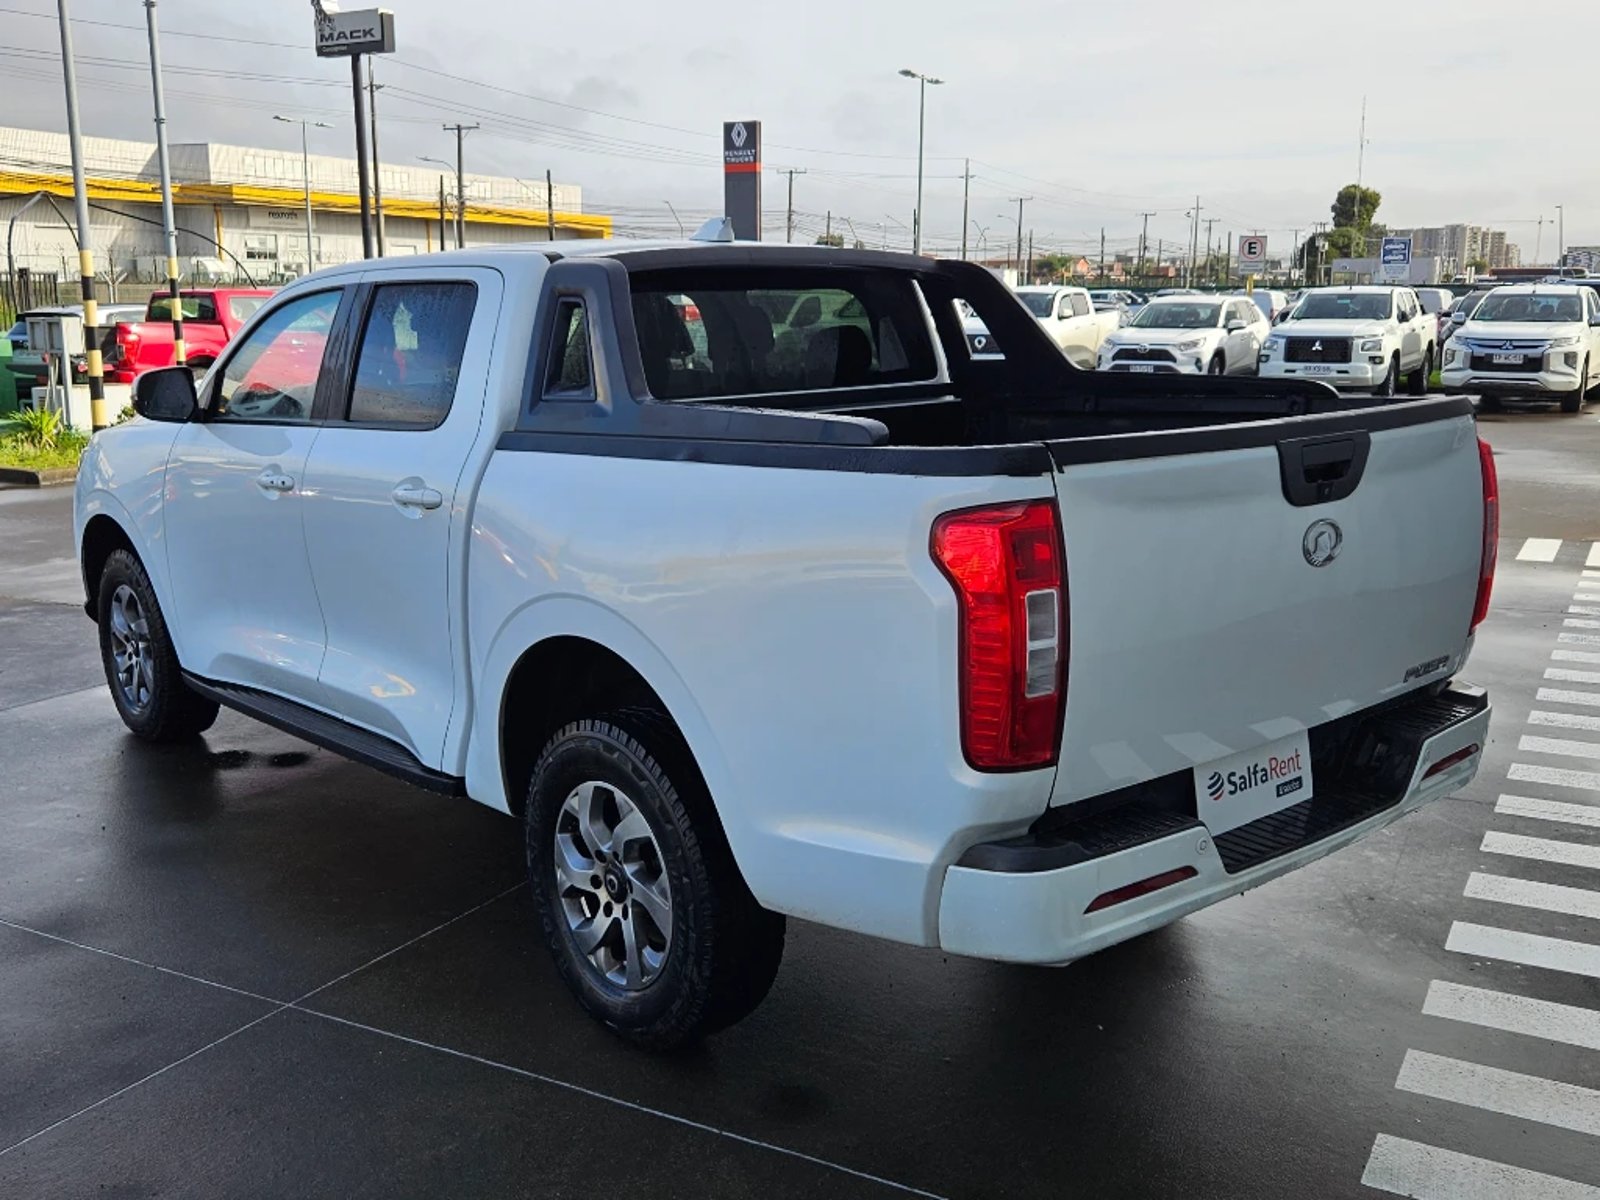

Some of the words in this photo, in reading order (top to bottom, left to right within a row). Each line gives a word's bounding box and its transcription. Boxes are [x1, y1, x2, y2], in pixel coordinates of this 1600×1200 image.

[320, 28, 375, 42] MACK
[724, 149, 755, 157] RENAULT
[1247, 241, 1258, 255] E
[1227, 748, 1302, 796] SalfaRent
